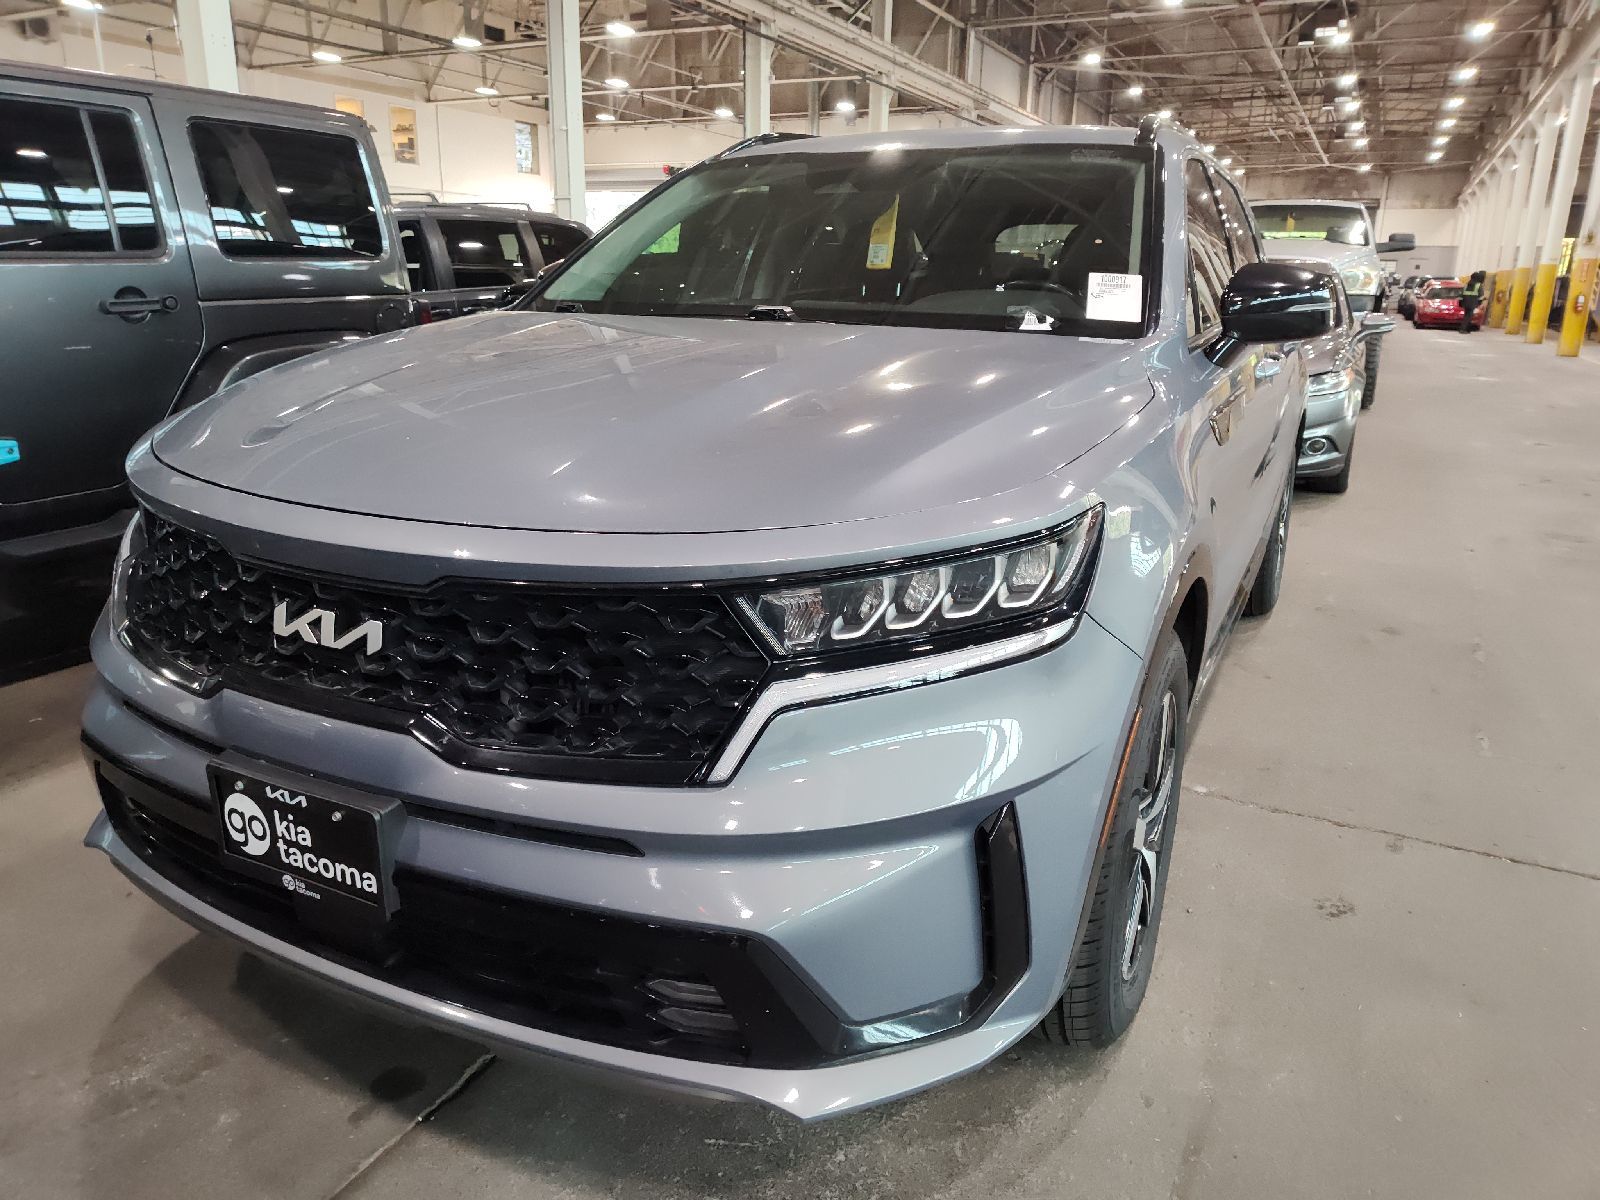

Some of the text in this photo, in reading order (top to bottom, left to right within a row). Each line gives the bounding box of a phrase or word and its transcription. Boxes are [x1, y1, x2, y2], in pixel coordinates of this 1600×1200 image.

[273, 601, 383, 656] KIA
[226, 807, 268, 850] go
[273, 809, 313, 848] kia
[276, 838, 378, 894] tacoma
[295, 886, 321, 900] tacoma
